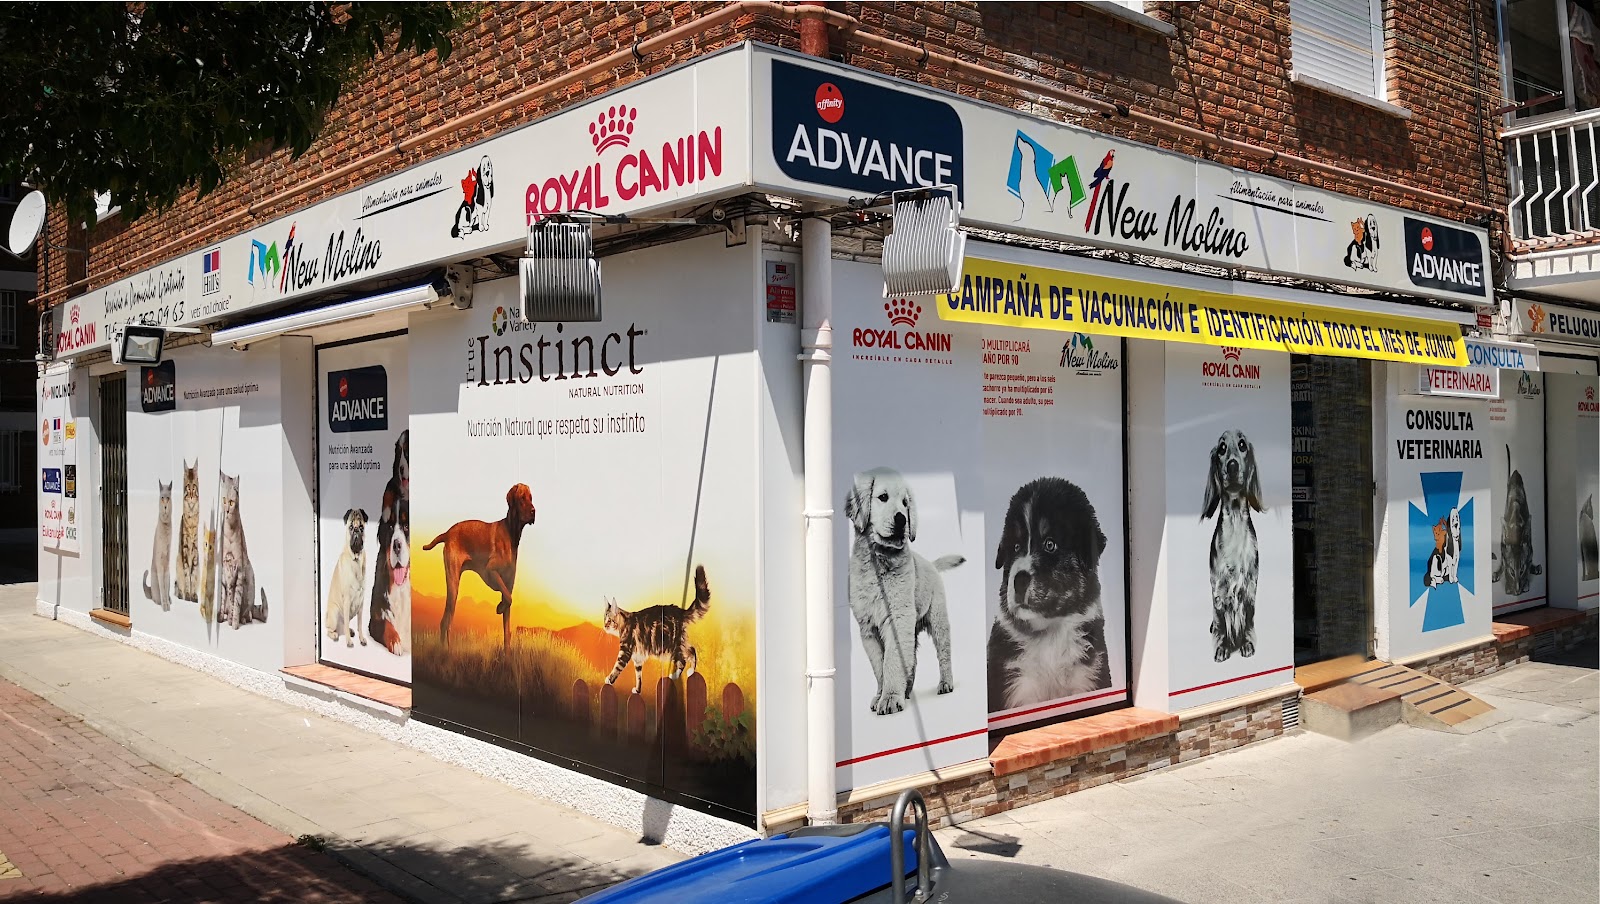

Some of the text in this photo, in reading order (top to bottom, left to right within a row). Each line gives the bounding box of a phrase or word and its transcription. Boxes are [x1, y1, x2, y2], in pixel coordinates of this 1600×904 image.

[817, 98, 843, 110] affinity
[786, 123, 953, 189] ADVANCE
[399, 185, 413, 201] para
[415, 171, 442, 192] animales
[525, 125, 722, 227] ROYAL CANIN
[1229, 180, 1324, 214] Alimentación para animales
[1094, 179, 1249, 258] New Molino
[285, 226, 382, 294] New Molino
[1412, 252, 1481, 287] ADVANCE
[75, 321, 97, 347] CANIN
[509, 320, 537, 333] Variety
[1049, 285, 1073, 321] DE
[1078, 288, 1185, 332] VACUNACIÓN
[1189, 303, 1200, 334] E
[1203, 306, 1325, 347] IDENTIFICACIÓN
[1323, 320, 1361, 350] TODO
[1361, 325, 1380, 352] EL
[1379, 327, 1405, 355] MES
[1405, 331, 1423, 357] DE
[1424, 332, 1456, 360] JUNIO
[1549, 312, 1600, 338] PELUQU
[852, 327, 951, 352] ROYAL CANIN
[987, 339, 1030, 353] MULTIPLICARÁ
[466, 337, 475, 388] True
[477, 323, 644, 387] Instinct
[997, 353, 1010, 365] POR
[1062, 347, 1119, 370] New Molino
[1467, 344, 1525, 369] CONSULTA
[1202, 361, 1260, 380] ROYAL CANIN
[1427, 368, 1492, 393] VETERINARIA
[143, 383, 174, 404] ADVANCE
[568, 383, 644, 399] NATURAL NUTRITION
[332, 397, 385, 422] ADVANCE
[1405, 409, 1474, 431] CONSULTA
[467, 412, 646, 440] Nutrición Natural que respeta su instinto
[1396, 439, 1483, 460] VETERINARIA
[349, 459, 362, 470] salud
